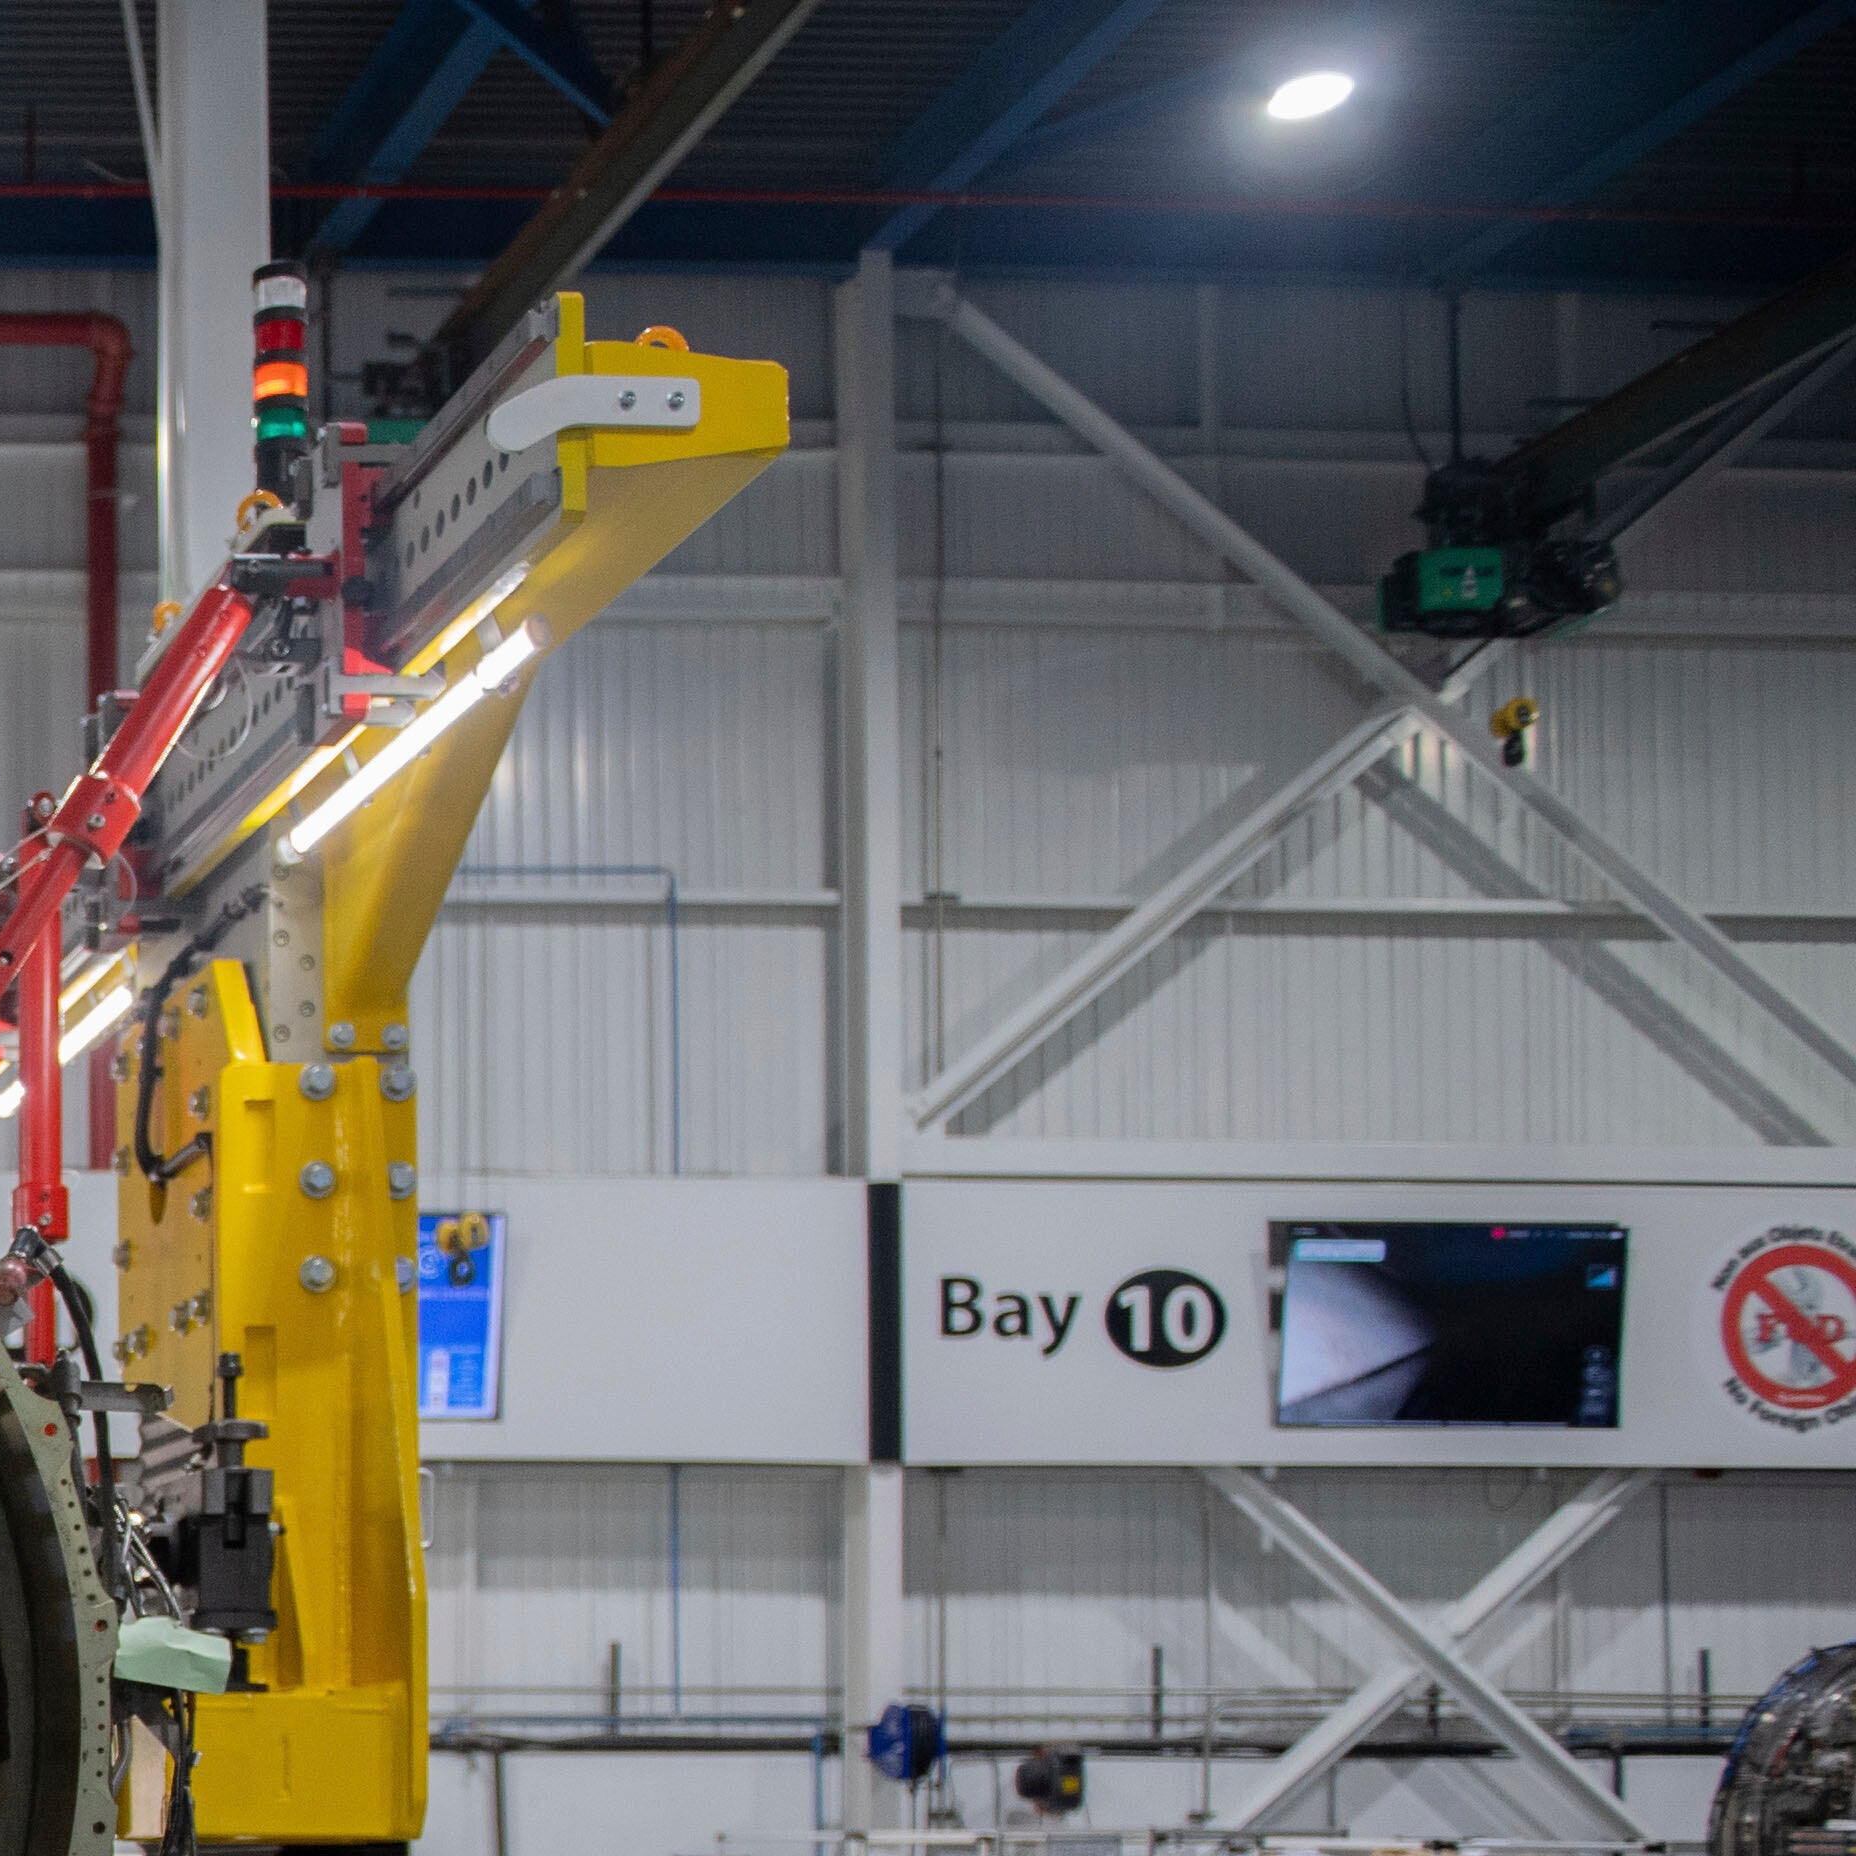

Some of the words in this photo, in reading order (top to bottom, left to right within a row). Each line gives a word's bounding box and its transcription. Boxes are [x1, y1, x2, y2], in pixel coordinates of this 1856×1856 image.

[940, 1277, 1080, 1356] Bay
[1116, 1283, 1215, 1354] 10
[1756, 1313, 1846, 1344] FD
